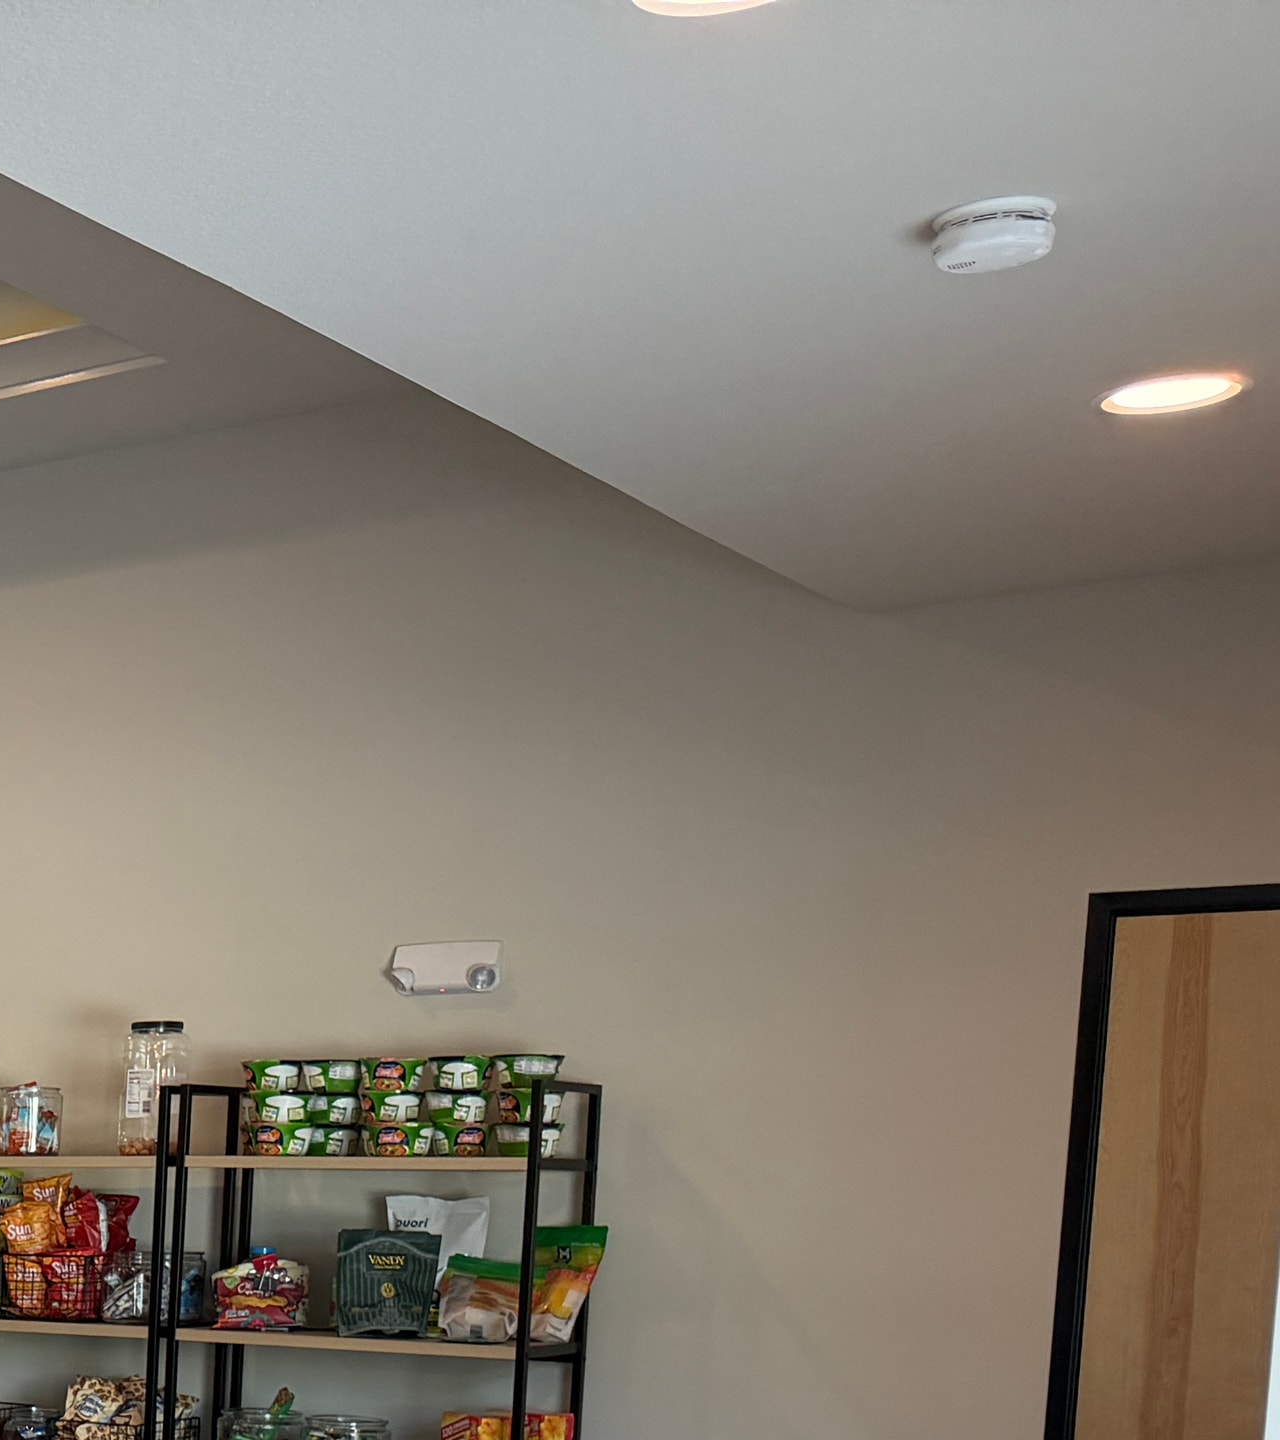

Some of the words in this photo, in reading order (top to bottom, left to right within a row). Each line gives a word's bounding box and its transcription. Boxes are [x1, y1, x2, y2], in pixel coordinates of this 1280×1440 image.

[33, 1186, 56, 1201] Sun
[7, 1223, 32, 1240] Sun
[368, 1254, 406, 1266] VANDY
[52, 1261, 78, 1274] Sun
